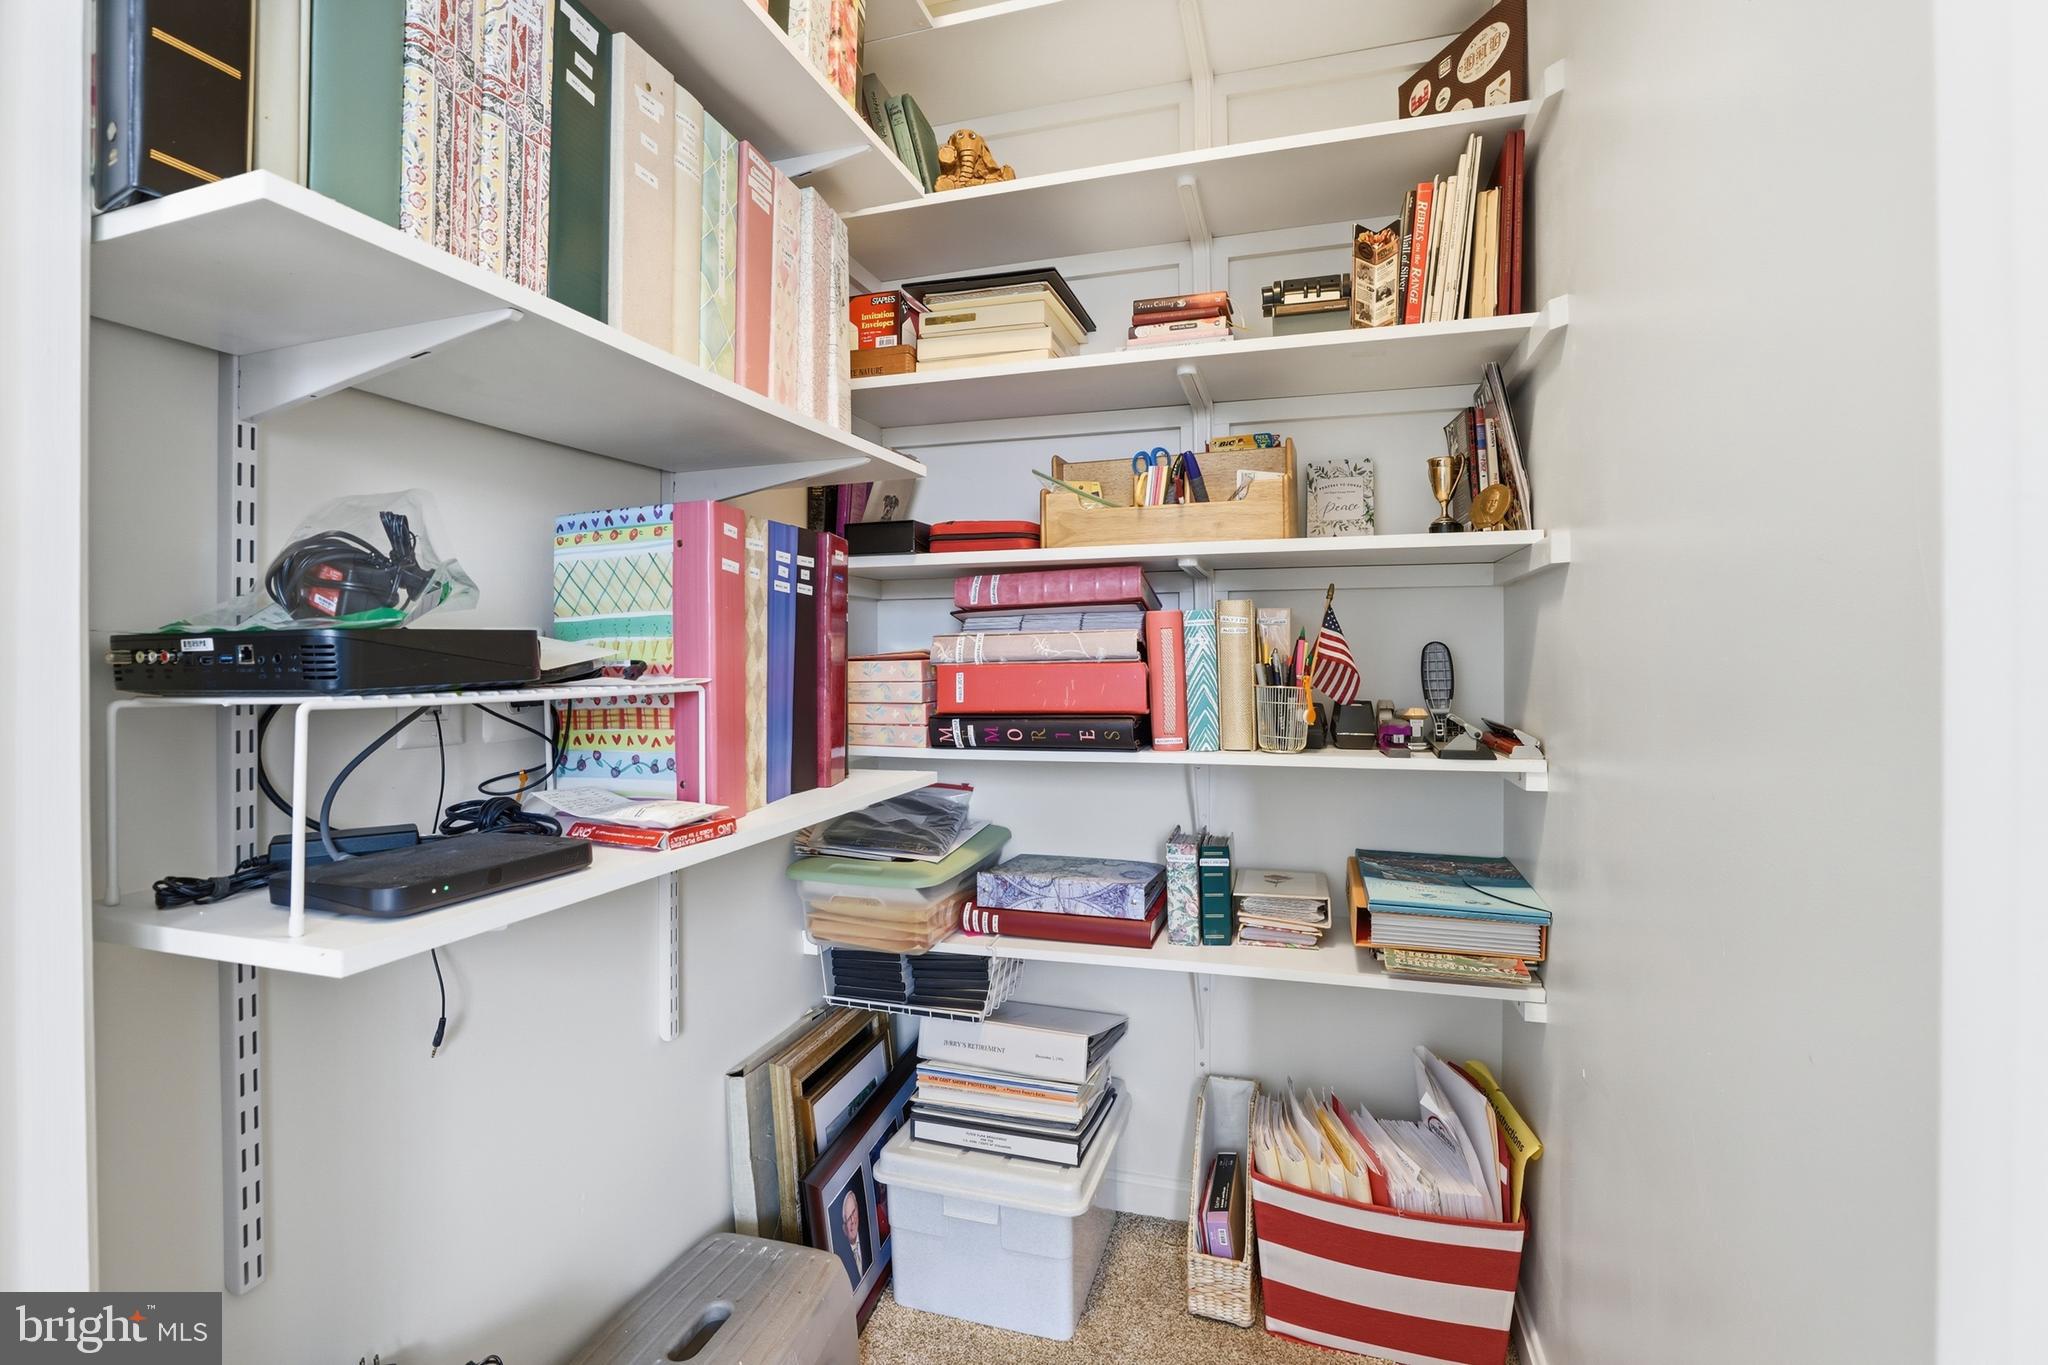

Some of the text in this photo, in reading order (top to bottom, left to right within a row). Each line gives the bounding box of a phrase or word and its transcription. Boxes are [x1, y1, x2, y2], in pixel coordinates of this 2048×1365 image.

[1415, 201, 1429, 241] REBELS
[1402, 234, 1412, 253] Wall
[1399, 266, 1409, 292] Silver
[1409, 268, 1422, 304] RANGE
[871, 296, 896, 305] STAPLES
[861, 310, 895, 321] Invitation
[861, 319, 894, 329] Envelopes
[943, 1039, 1006, 1054] JERRY'S RETIREMENT
[967, 1080, 997, 1090] PROTECTION
[1494, 1105, 1525, 1153] Instructions
